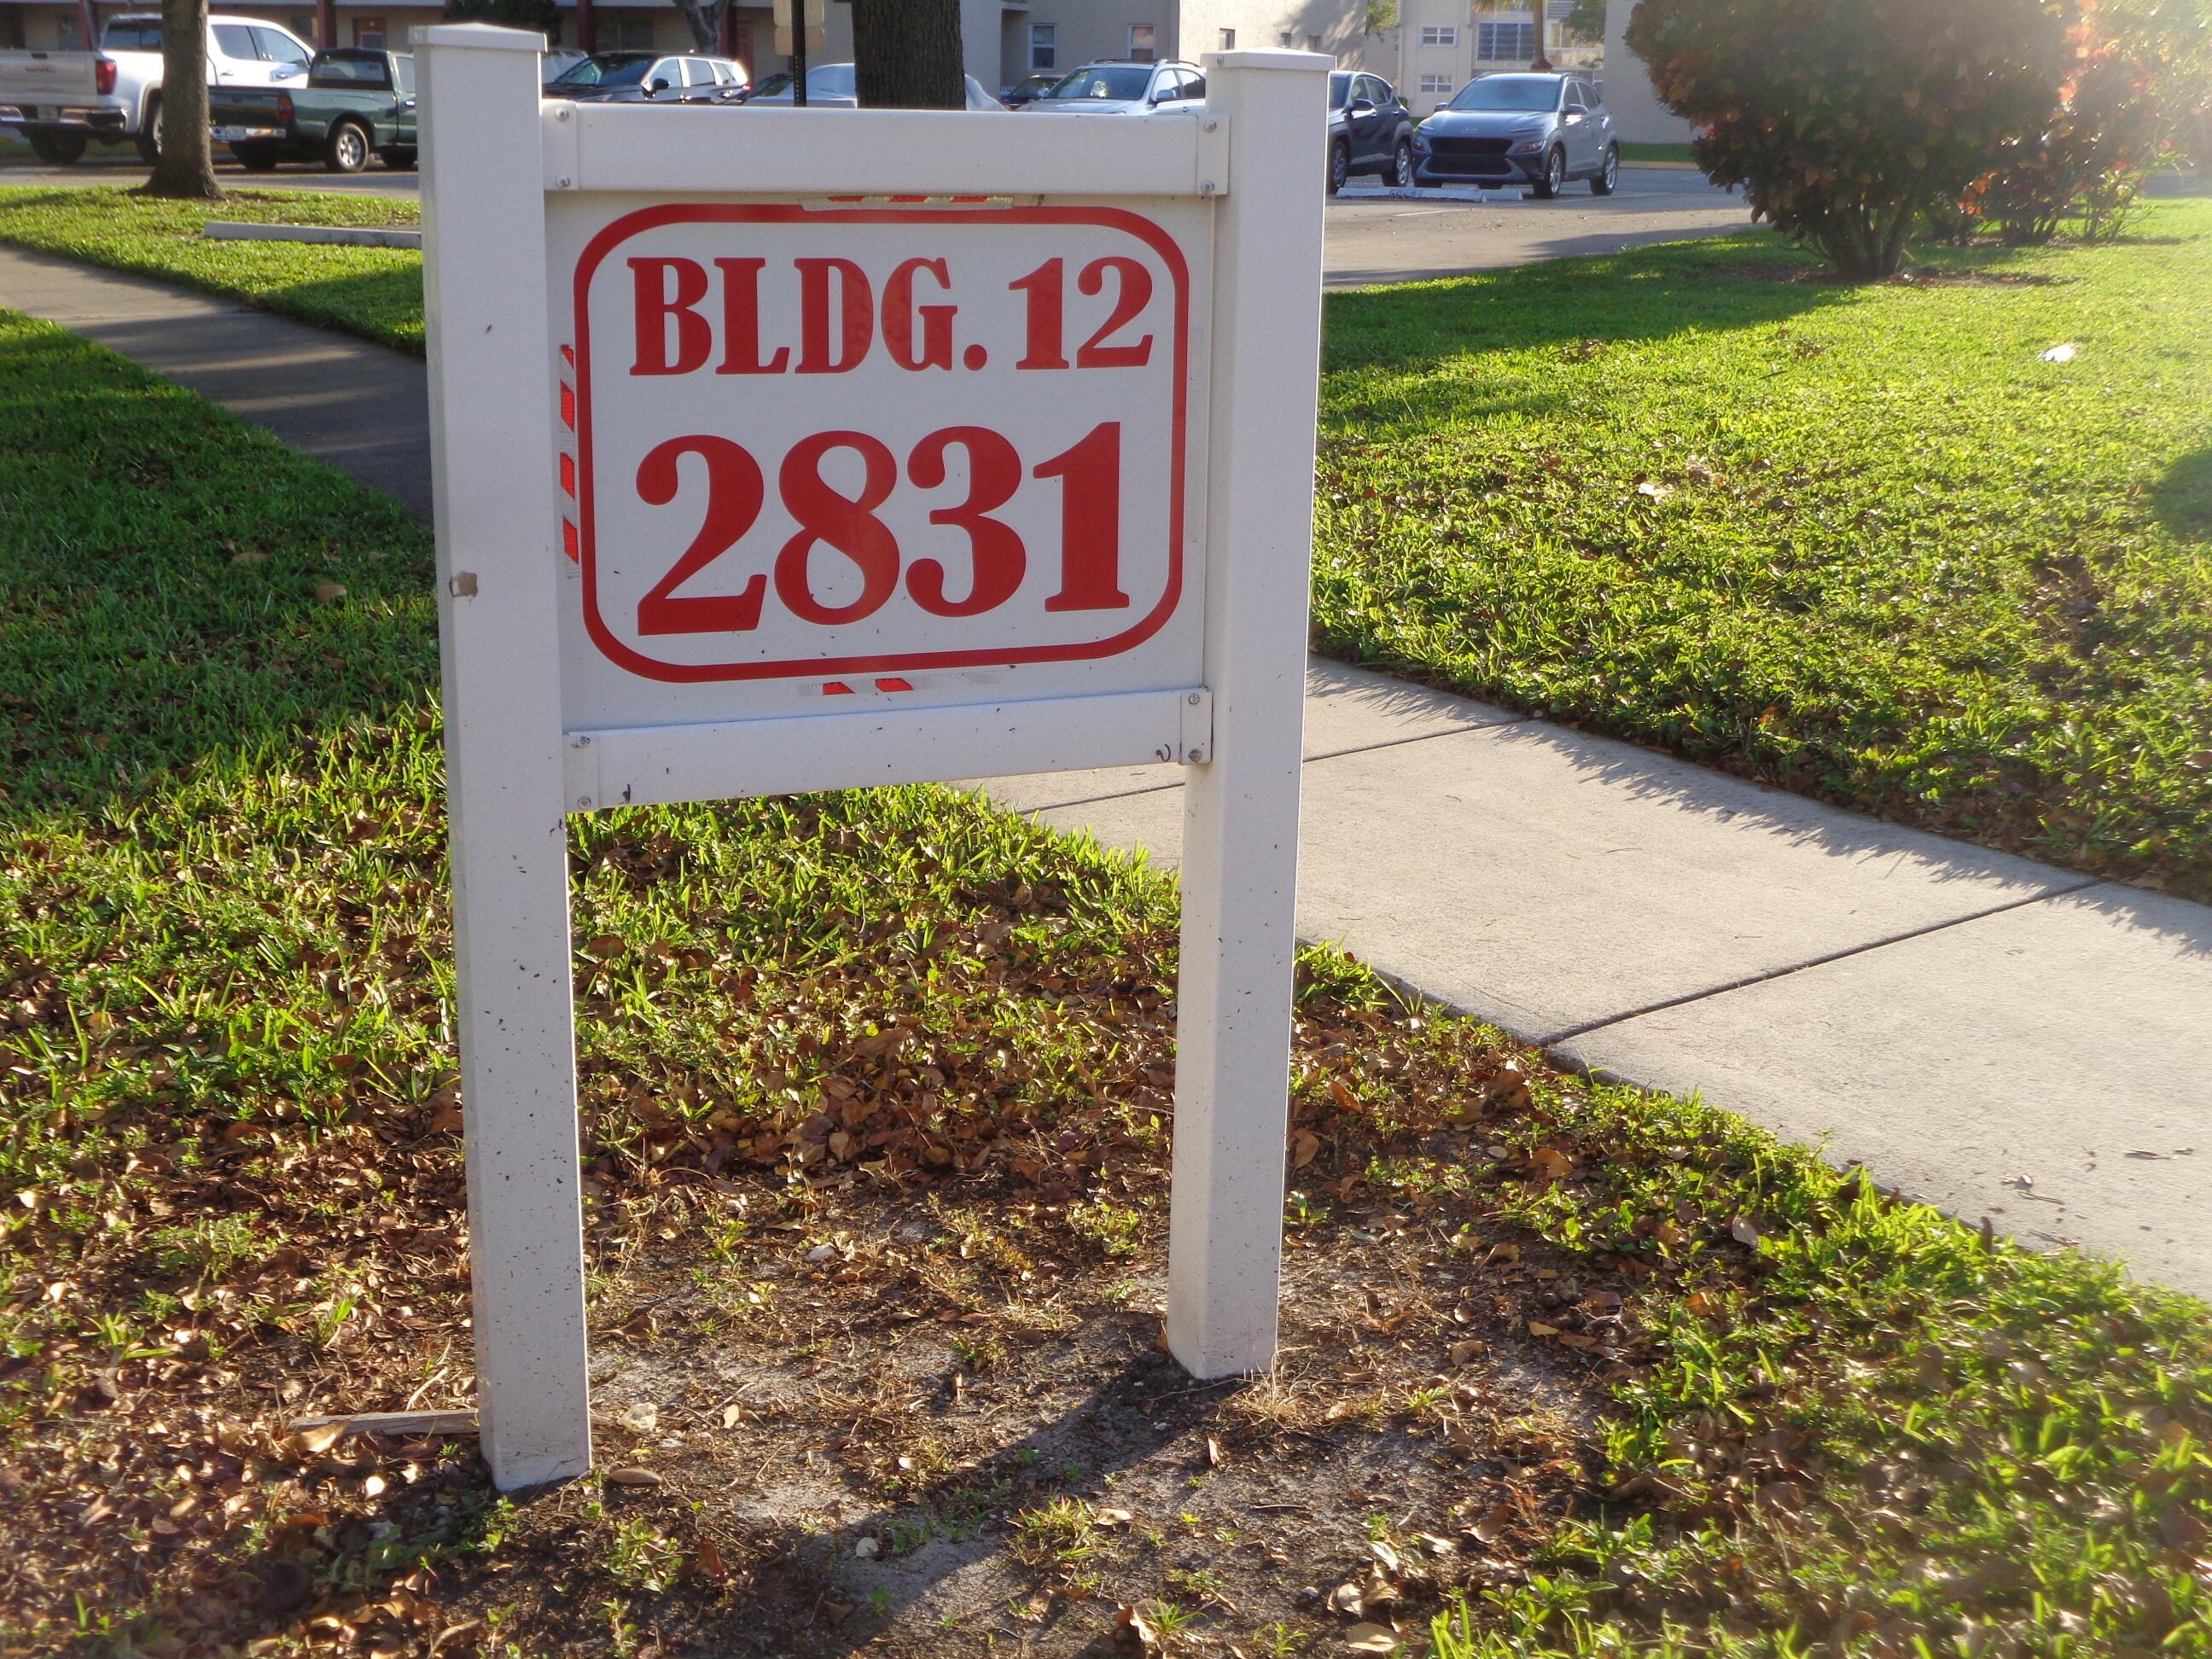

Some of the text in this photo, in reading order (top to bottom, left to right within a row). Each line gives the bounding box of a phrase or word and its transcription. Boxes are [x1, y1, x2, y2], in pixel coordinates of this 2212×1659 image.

[627, 256, 1154, 375] BLDG. 12
[636, 422, 1131, 636] 2831
